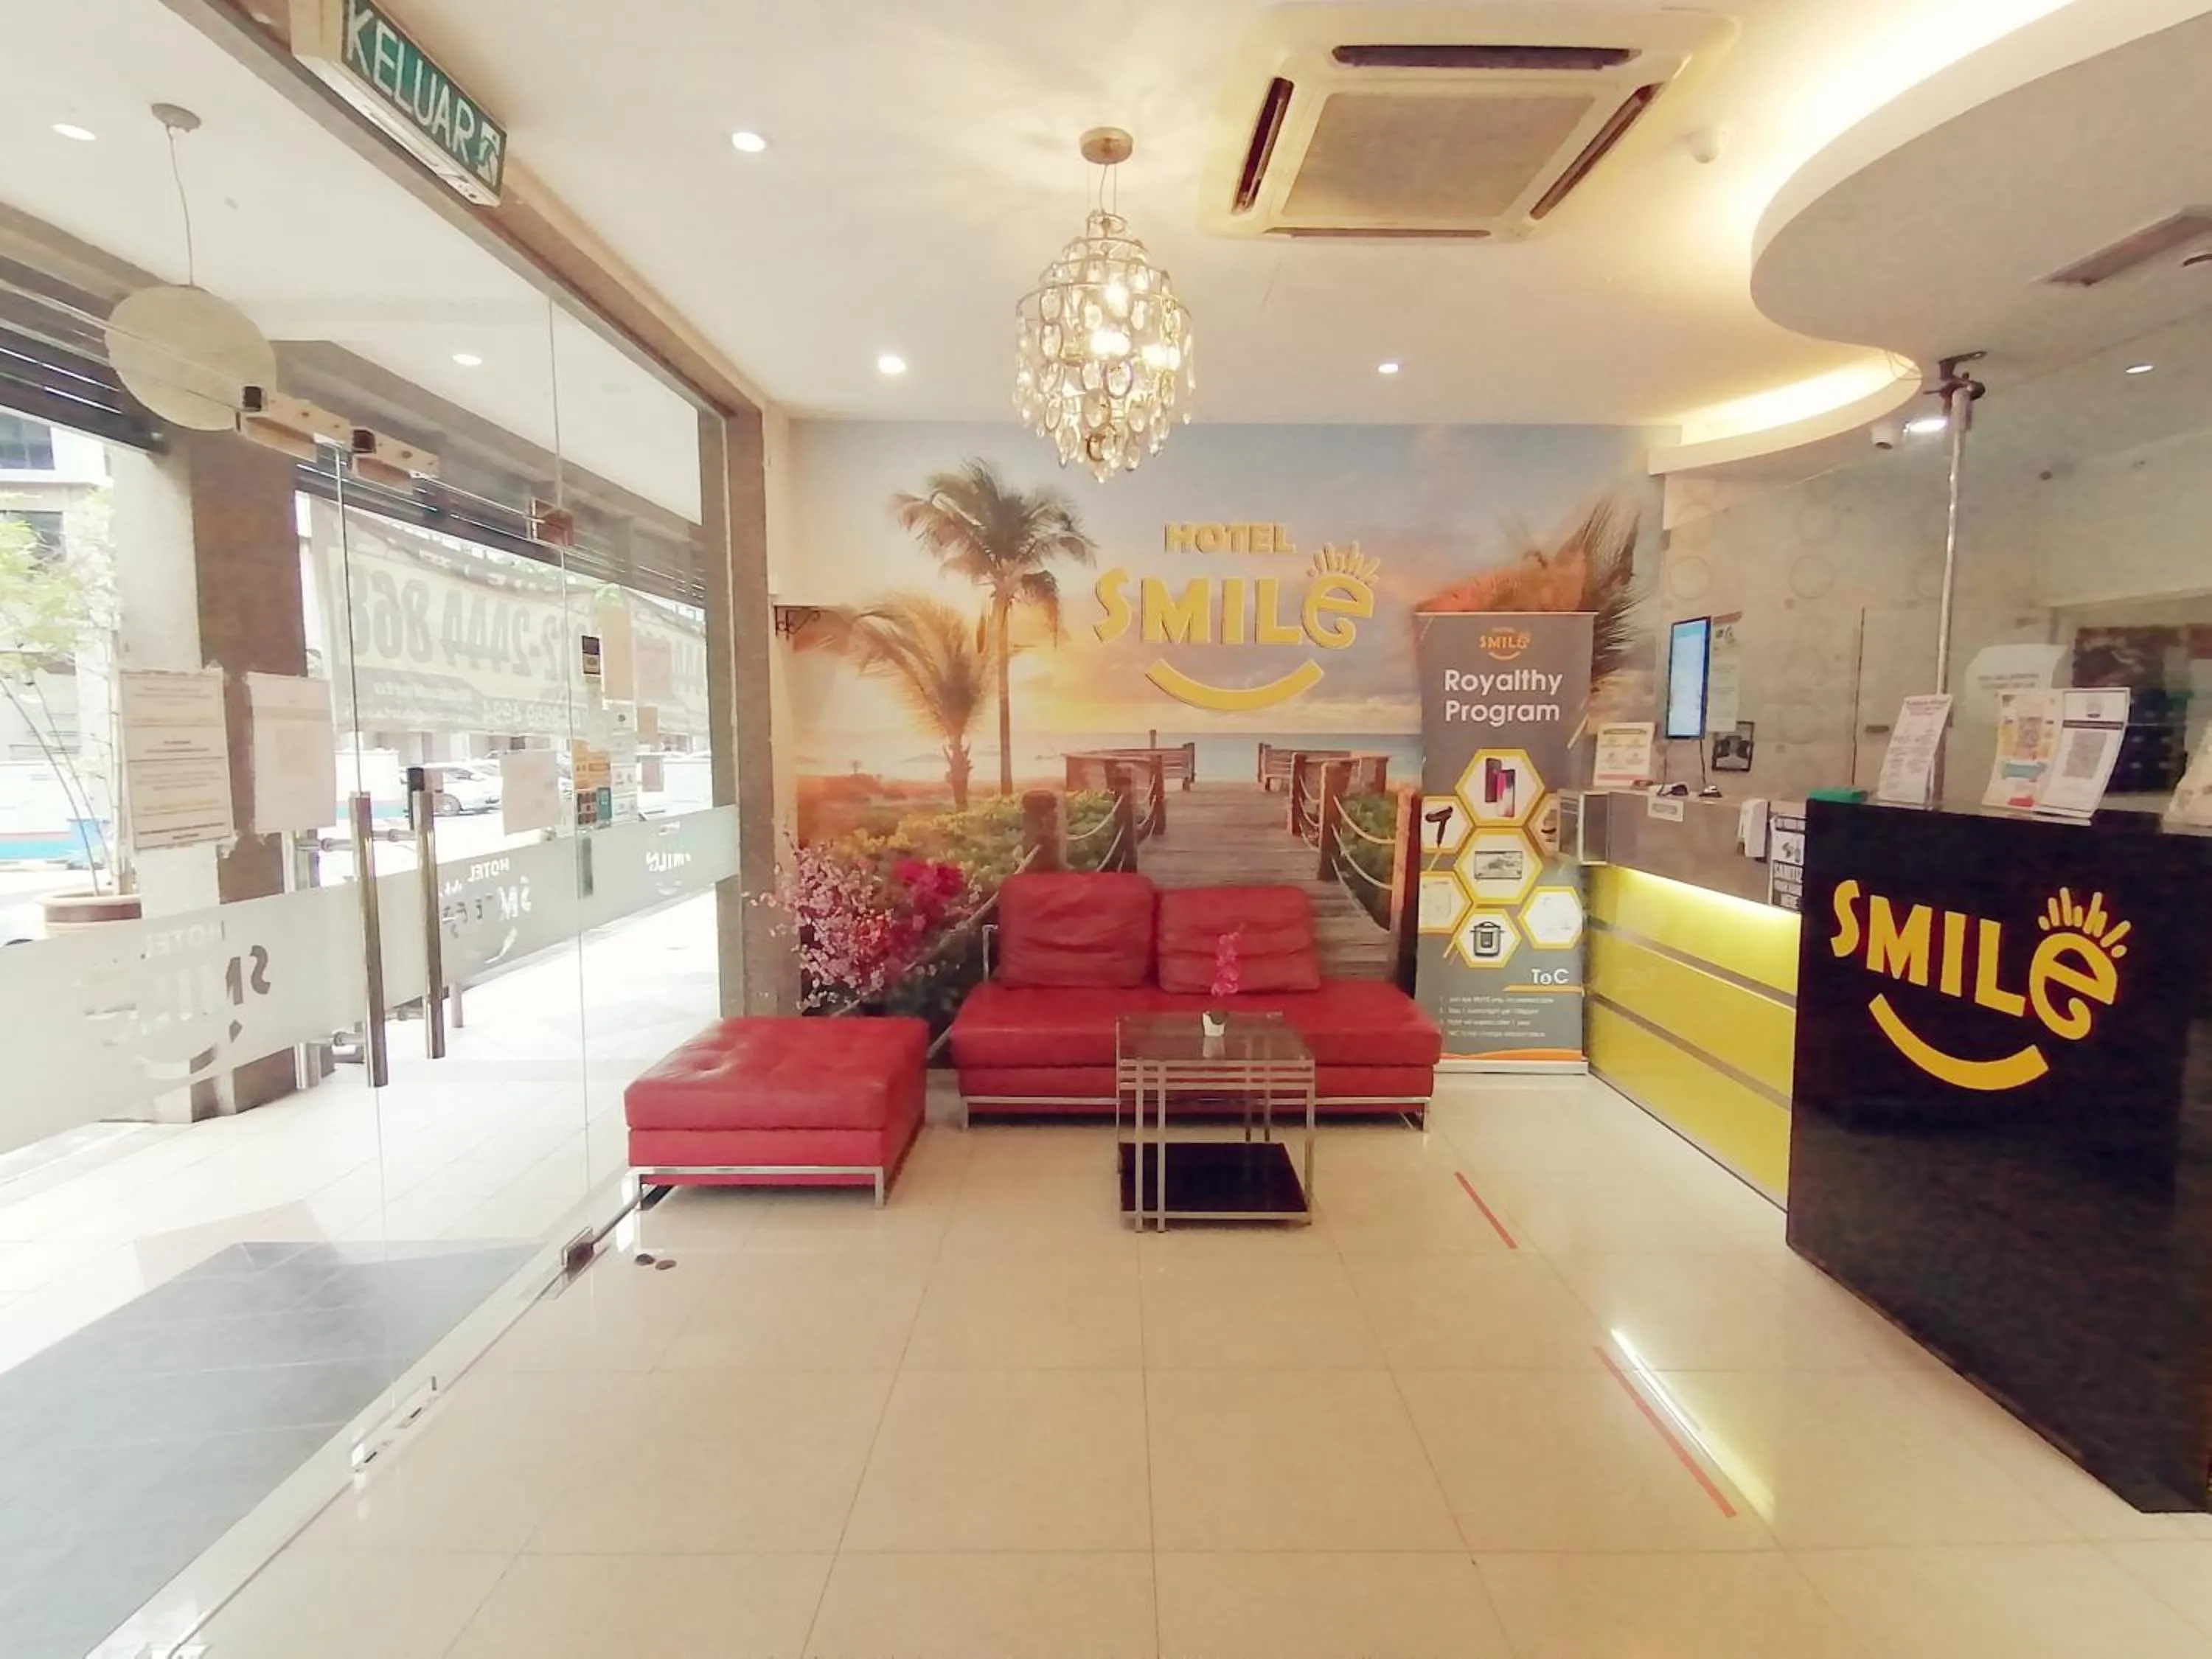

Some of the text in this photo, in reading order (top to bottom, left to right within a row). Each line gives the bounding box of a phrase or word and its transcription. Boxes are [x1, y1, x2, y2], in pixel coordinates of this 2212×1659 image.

[347, 0, 475, 164] KELUAR
[1165, 521, 1298, 554] HOTEL
[1444, 669, 1563, 695] Royalthy
[1445, 700, 1559, 727] Program
